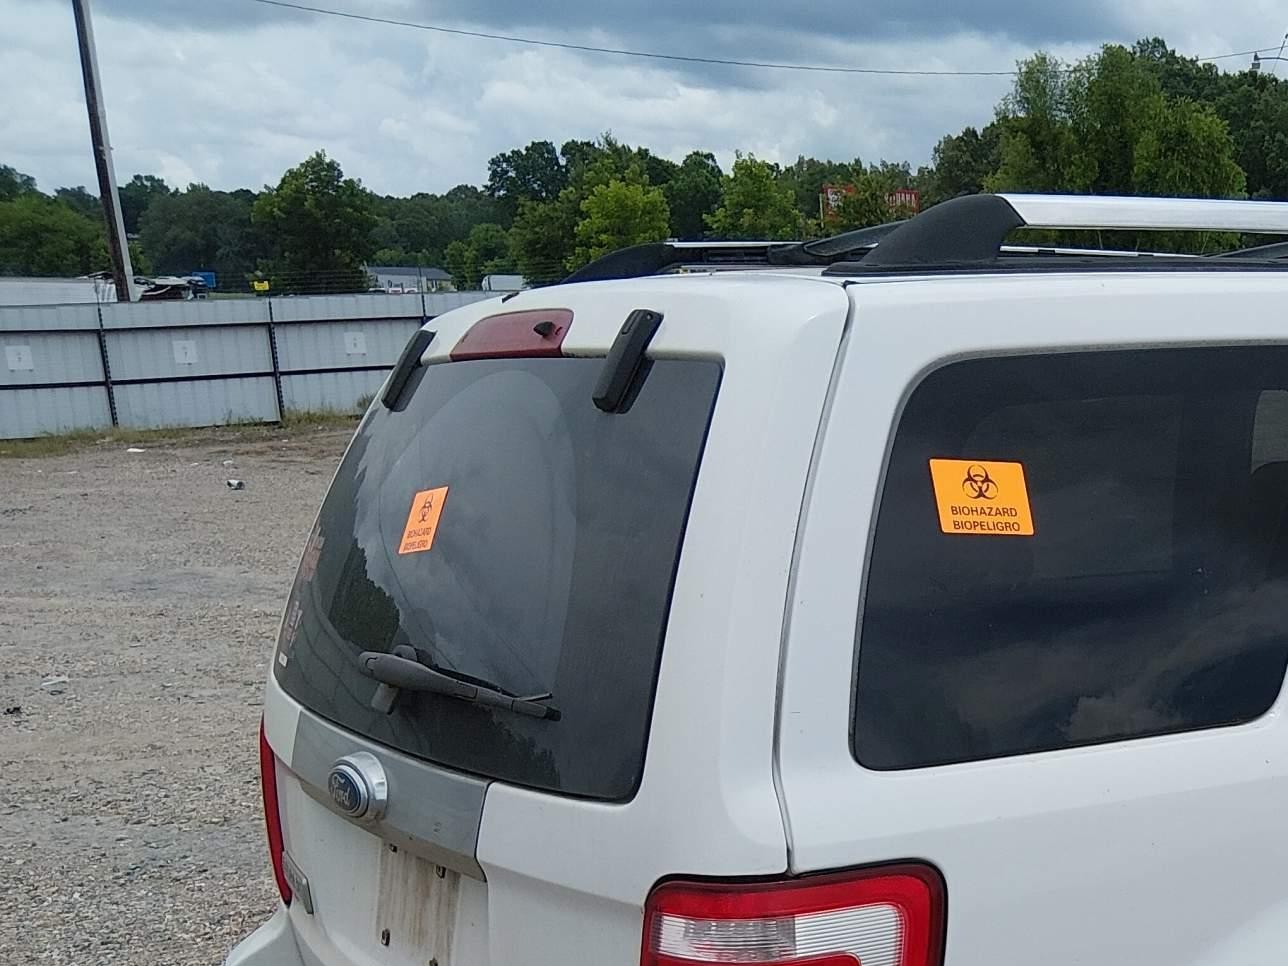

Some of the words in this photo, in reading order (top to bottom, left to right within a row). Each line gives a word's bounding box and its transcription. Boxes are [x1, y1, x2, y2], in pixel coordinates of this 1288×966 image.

[950, 505, 1018, 517] BIOHAZARD
[953, 520, 1021, 532] BIOPELIGRO
[330, 773, 352, 807] Ford
